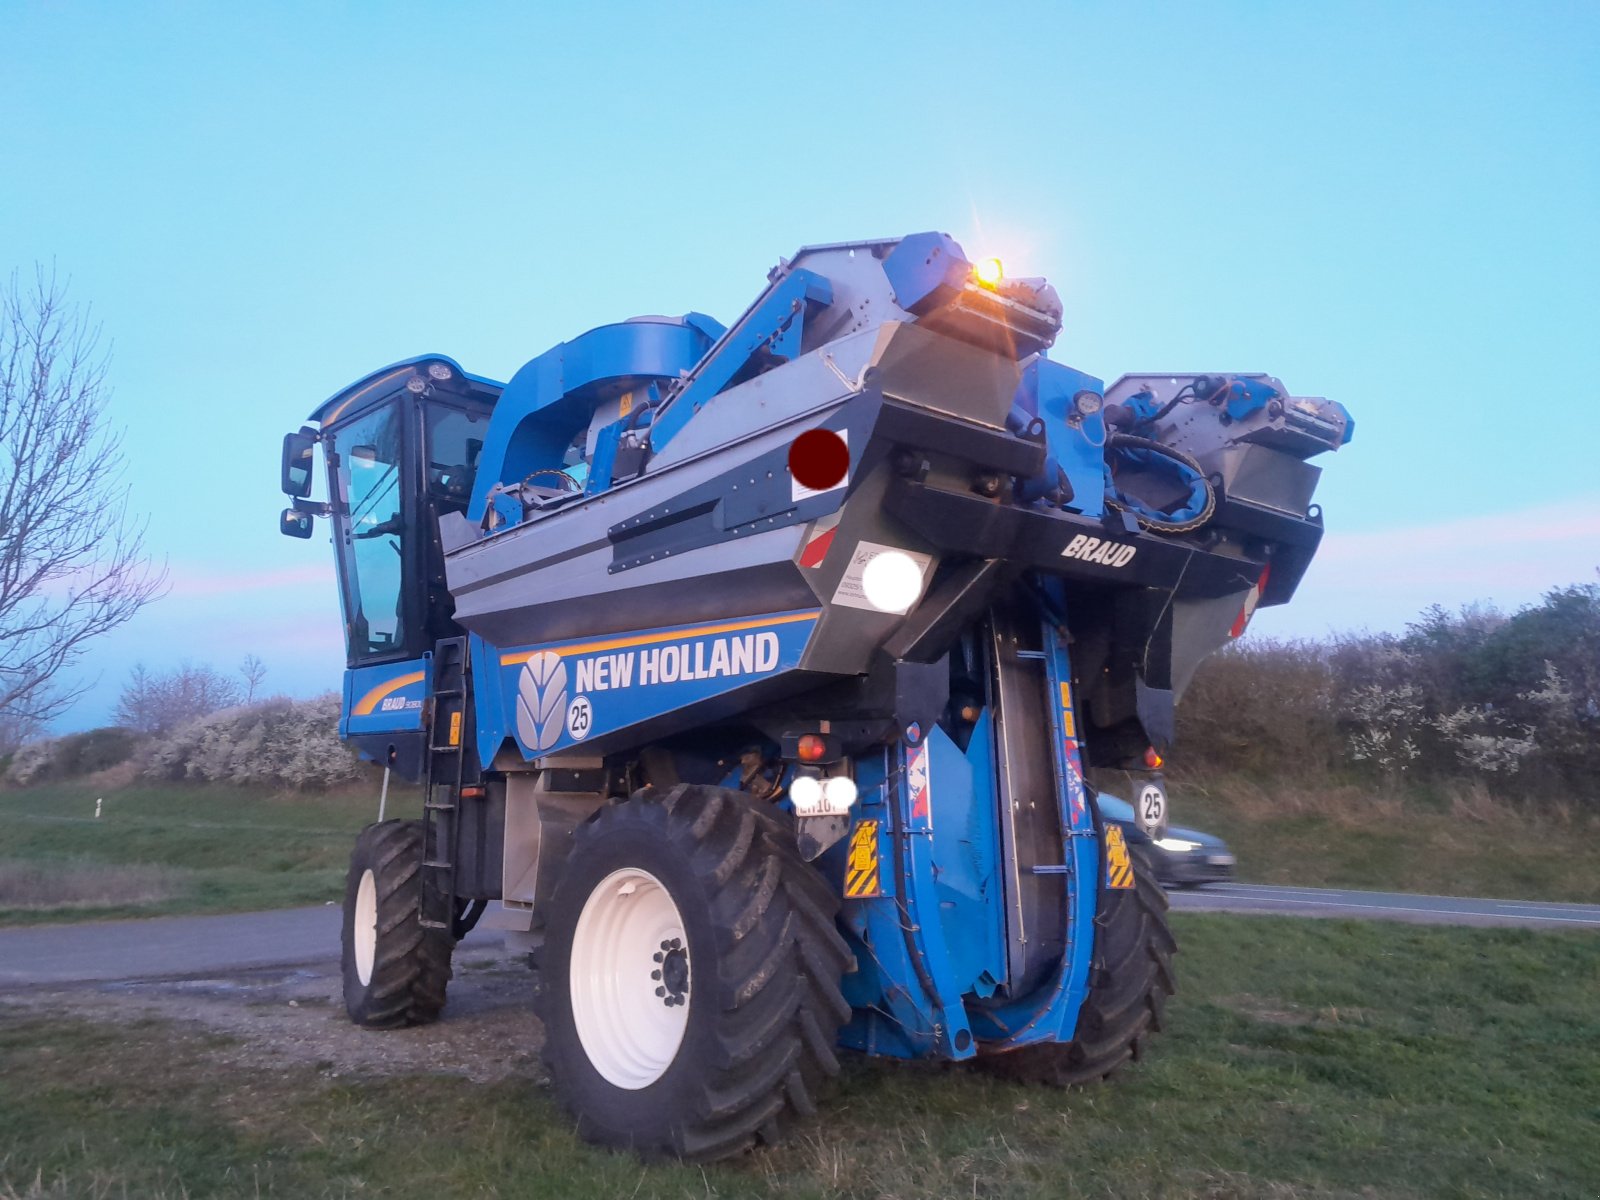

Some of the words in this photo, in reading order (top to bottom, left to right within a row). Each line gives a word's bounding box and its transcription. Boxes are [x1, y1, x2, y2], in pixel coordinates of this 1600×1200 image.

[1060, 533, 1137, 568] BRAUD
[575, 651, 635, 693] NEW
[639, 631, 780, 686] HOLLAND
[571, 704, 588, 731] 25
[1144, 792, 1162, 820] 25
